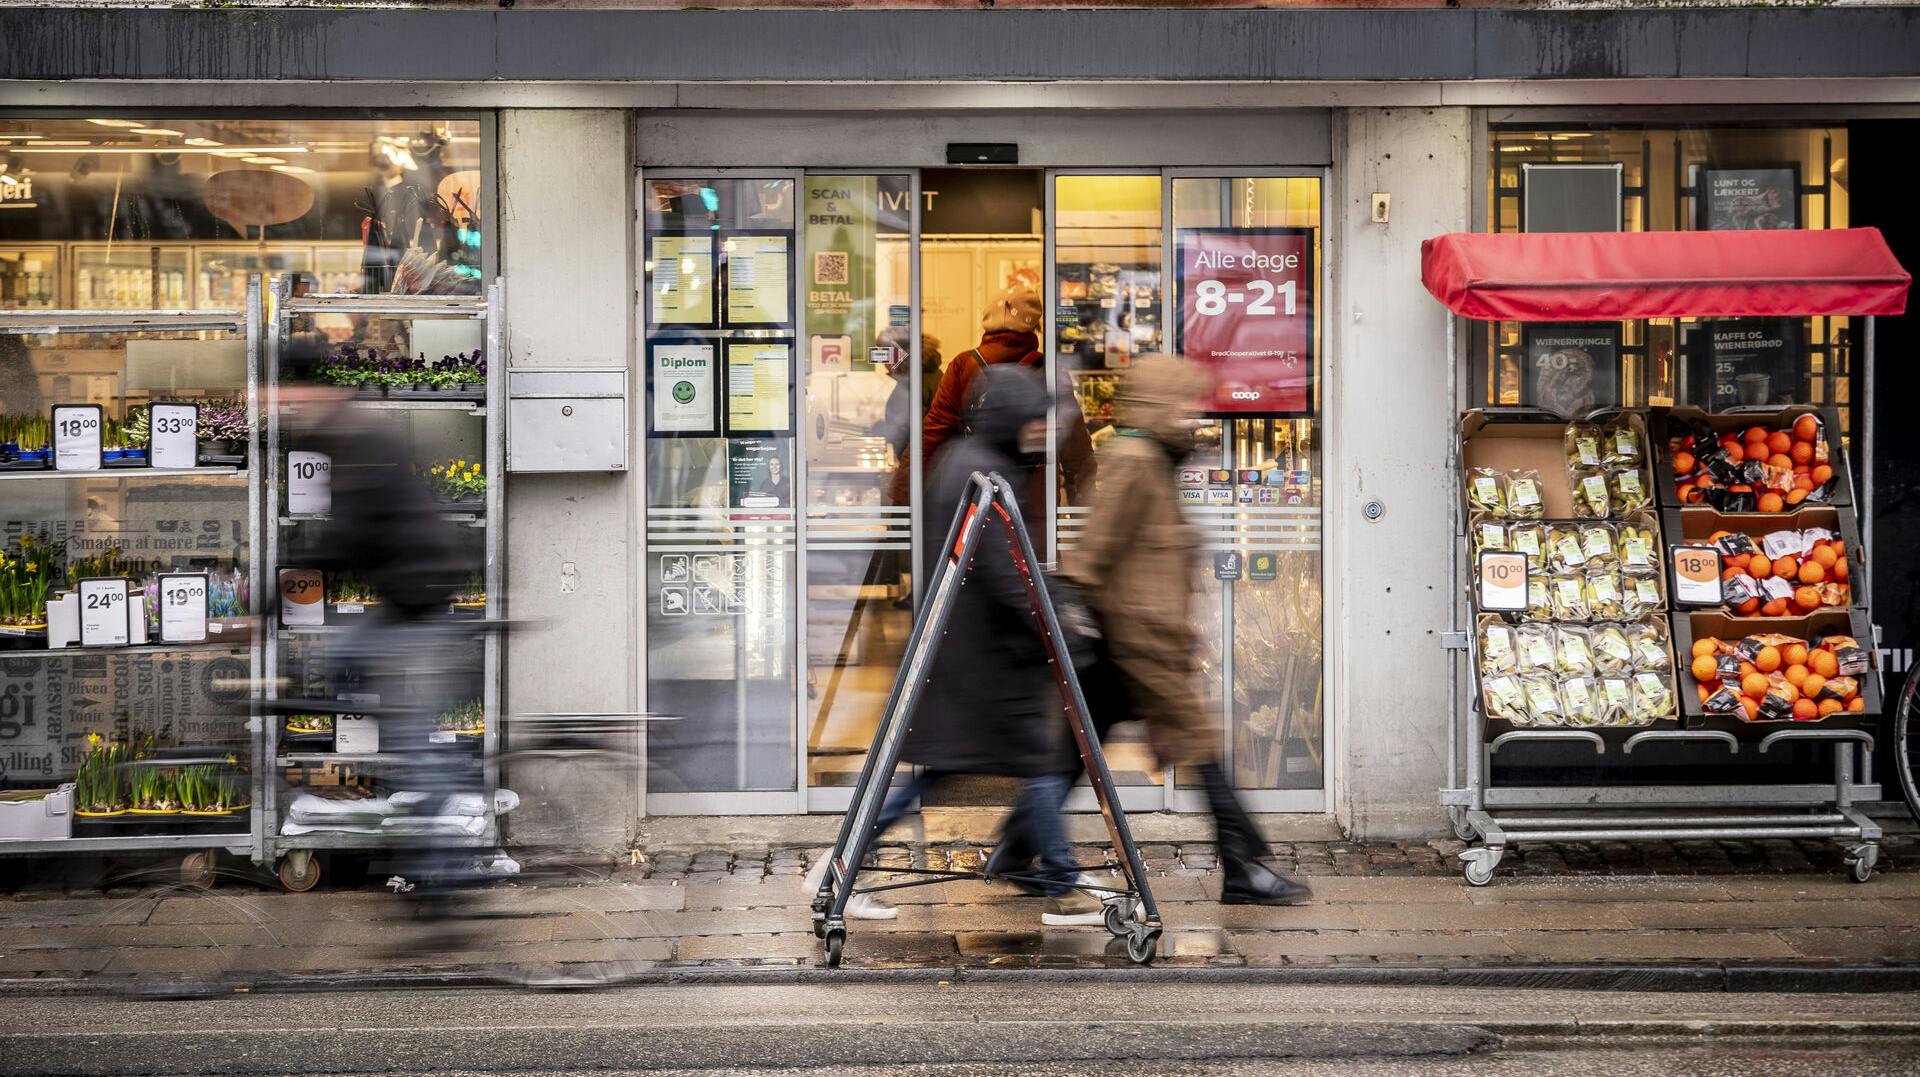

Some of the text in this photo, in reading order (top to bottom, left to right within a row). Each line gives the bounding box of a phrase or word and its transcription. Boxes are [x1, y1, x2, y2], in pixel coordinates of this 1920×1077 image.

[1713, 179, 1756, 188] LUNT OG
[811, 189, 851, 200] SCAN
[1713, 188, 1759, 197] LÆKKERT
[825, 202, 837, 213] &
[808, 214, 855, 225] BETAL
[1194, 250, 1236, 269] Alle
[809, 291, 854, 302] BETAL
[1195, 279, 1297, 316] 8-21
[1535, 337, 1613, 346] WIENERKRINGLE
[1713, 331, 1764, 341] KAFFE OG
[1714, 339, 1783, 350] WIENERBRØD
[661, 357, 707, 369] Diplom
[1231, 391, 1260, 401] coop
[1182, 491, 1202, 499] VISA
[1212, 490, 1230, 499] VISA
[72, 535, 193, 550] Smagen af mere
[68, 681, 108, 695] Oliven
[68, 708, 105, 722] Tonic
[0, 751, 54, 775] ylling
